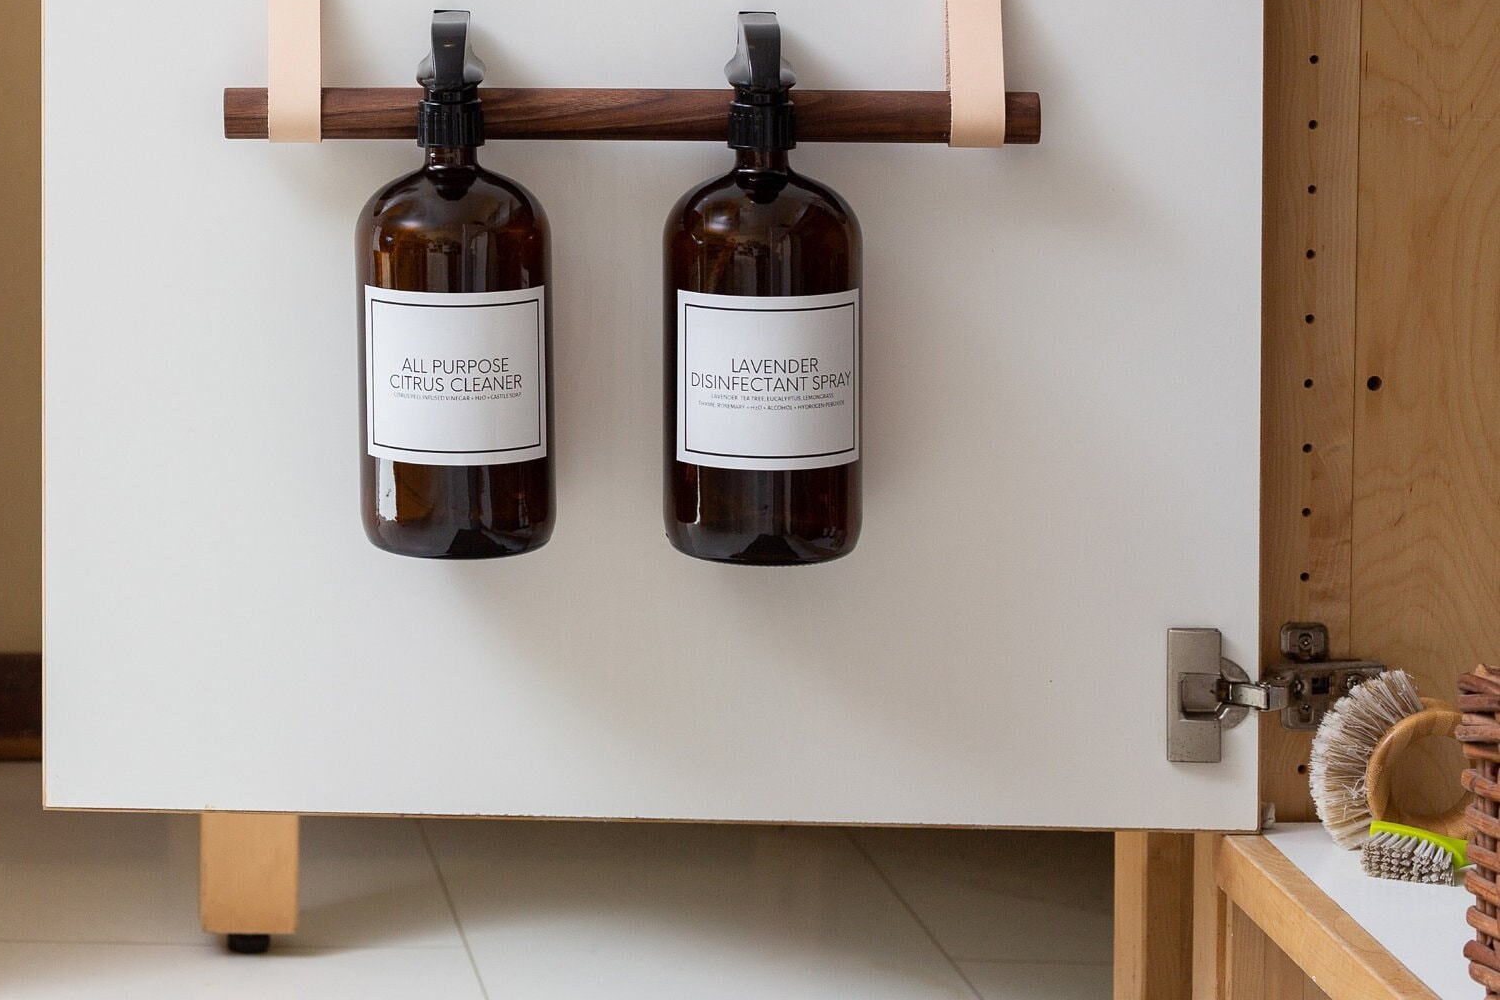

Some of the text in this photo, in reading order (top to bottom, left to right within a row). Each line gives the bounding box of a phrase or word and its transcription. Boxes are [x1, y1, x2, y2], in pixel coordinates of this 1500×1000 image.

[401, 357, 510, 375] ALL PURPOSE
[731, 357, 819, 374] LAVENDER
[389, 374, 523, 393] CITRUS CLEANER
[691, 370, 851, 392] DISINFECTANT SPRAY
